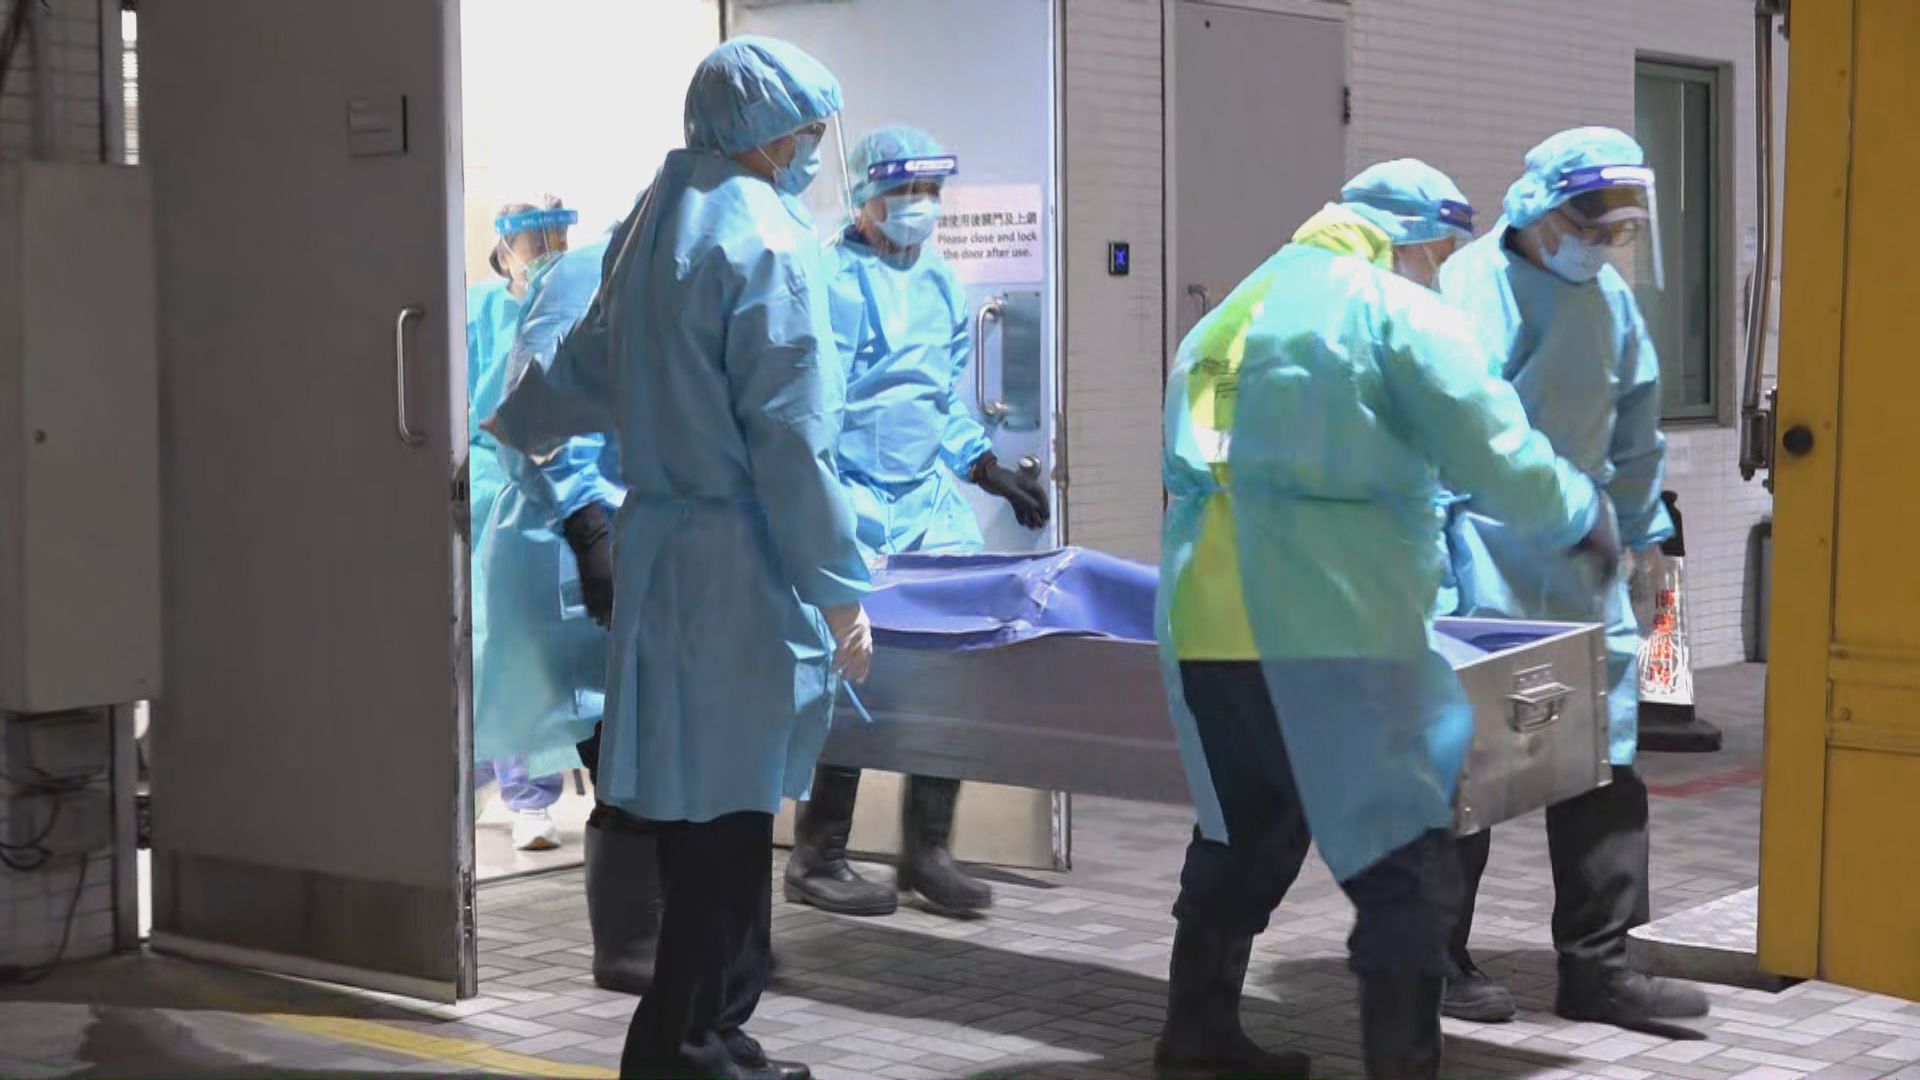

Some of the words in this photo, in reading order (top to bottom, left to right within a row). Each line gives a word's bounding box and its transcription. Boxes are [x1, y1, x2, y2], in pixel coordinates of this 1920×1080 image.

[938, 233, 968, 244] Please
[970, 231, 995, 244] close
[997, 231, 1015, 242] and
[1017, 231, 1038, 242] lock
[944, 249, 959, 258] the
[961, 249, 984, 259] door
[986, 248, 1010, 258] after
[1012, 248, 1032, 257] use.
